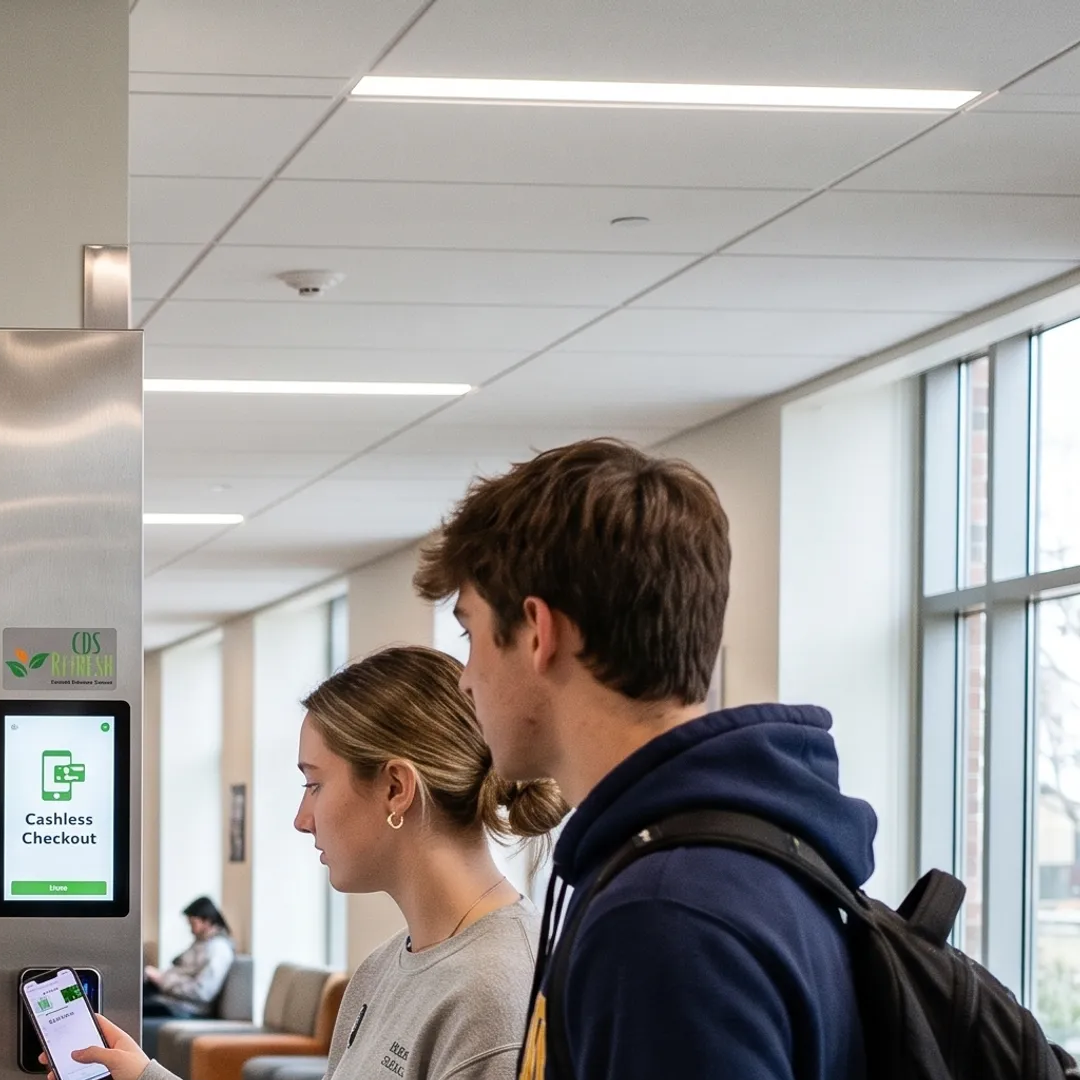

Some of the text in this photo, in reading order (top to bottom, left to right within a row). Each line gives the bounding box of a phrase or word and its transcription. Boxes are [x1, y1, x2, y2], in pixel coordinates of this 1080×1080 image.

[71, 631, 101, 655] CDS
[25, 812, 93, 826] Cashless
[22, 831, 97, 844] Checkout
